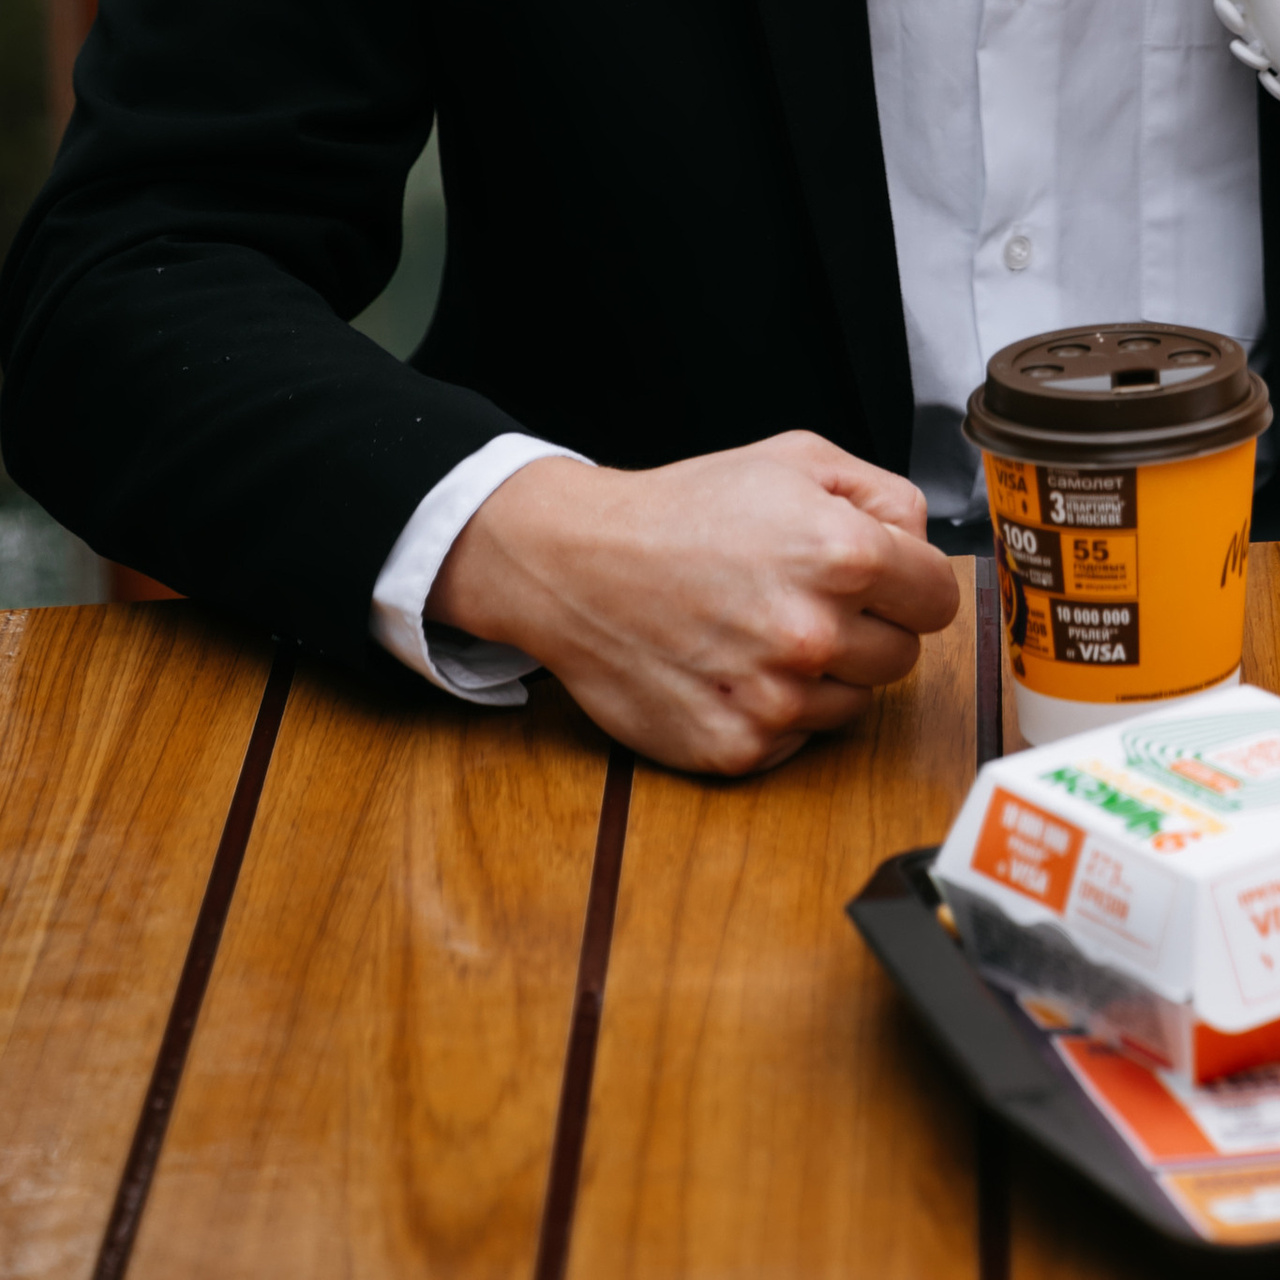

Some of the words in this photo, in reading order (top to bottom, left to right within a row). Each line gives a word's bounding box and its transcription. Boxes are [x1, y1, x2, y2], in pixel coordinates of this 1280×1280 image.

[995, 467, 1028, 494] VISA
[1050, 491, 1066, 524] 3
[1003, 523, 1037, 555] 100
[1073, 538, 1109, 561] 55
[1056, 606, 1071, 623] 10
[1074, 608, 1100, 626] 000
[1102, 608, 1130, 626] 000
[1078, 643, 1126, 662] VISA
